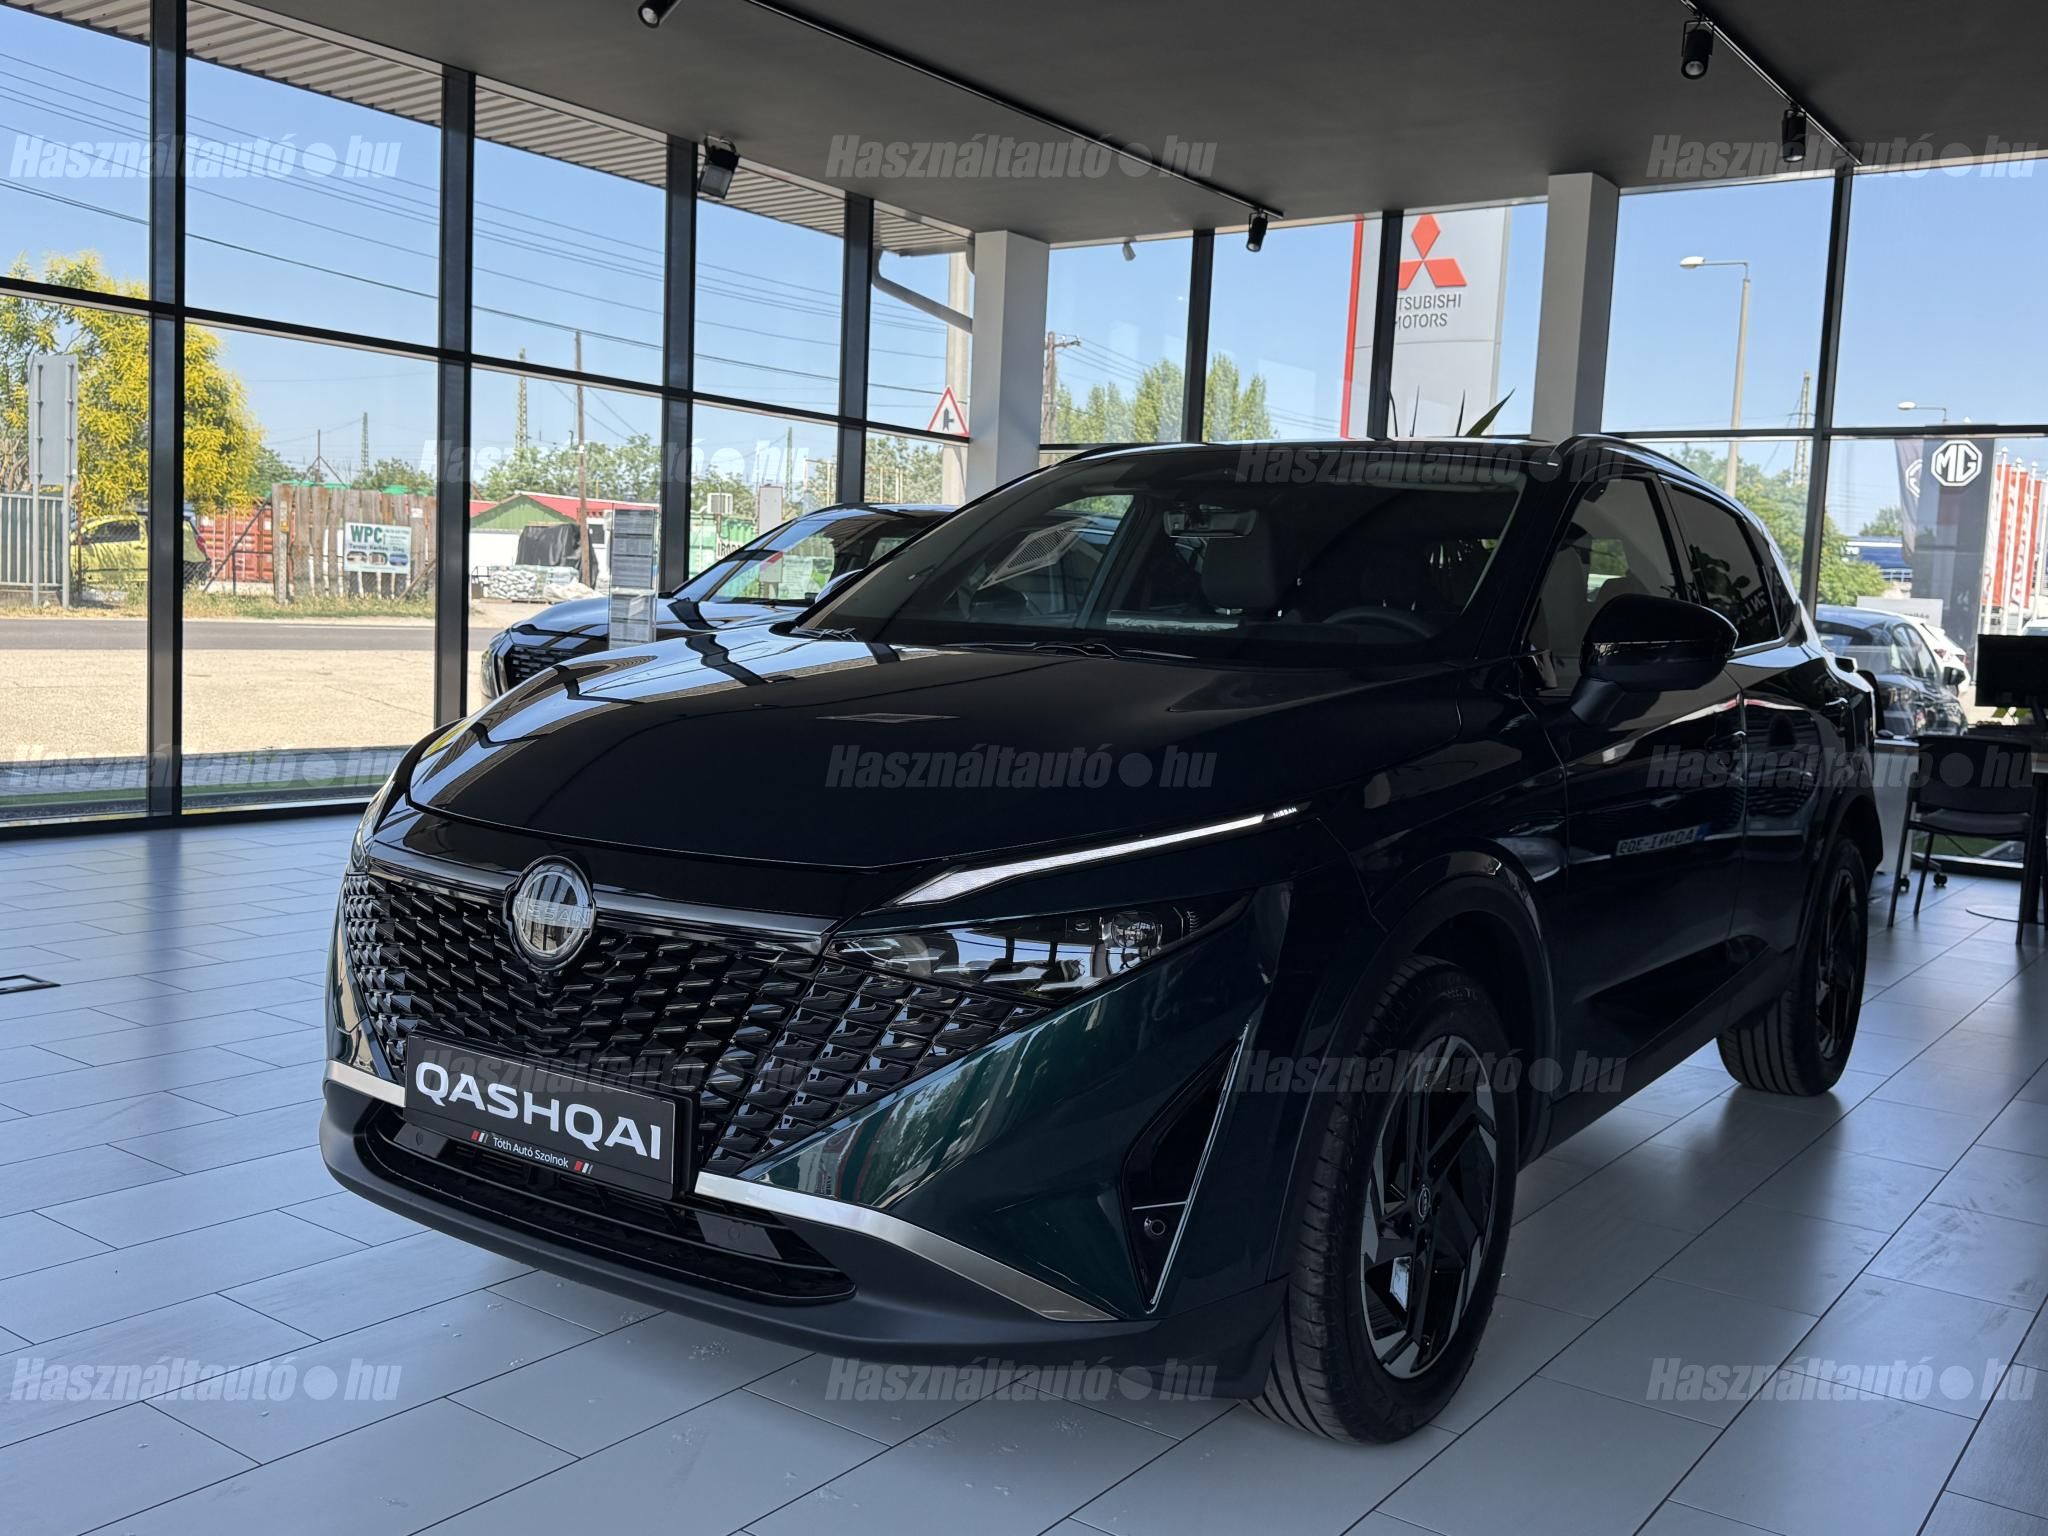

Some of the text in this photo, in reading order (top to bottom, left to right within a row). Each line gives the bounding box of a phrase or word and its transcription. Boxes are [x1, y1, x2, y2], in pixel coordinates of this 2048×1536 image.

[1397, 294, 1462, 310] TSUBISHI
[1935, 443, 1978, 484] MG
[351, 525, 383, 543] WPC
[717, 543, 741, 557] IROD
[1273, 807, 1297, 817] NISSAN
[415, 1061, 662, 1160] QASHQAI
[493, 1136, 569, 1168] Tóth Autó Szolnok
